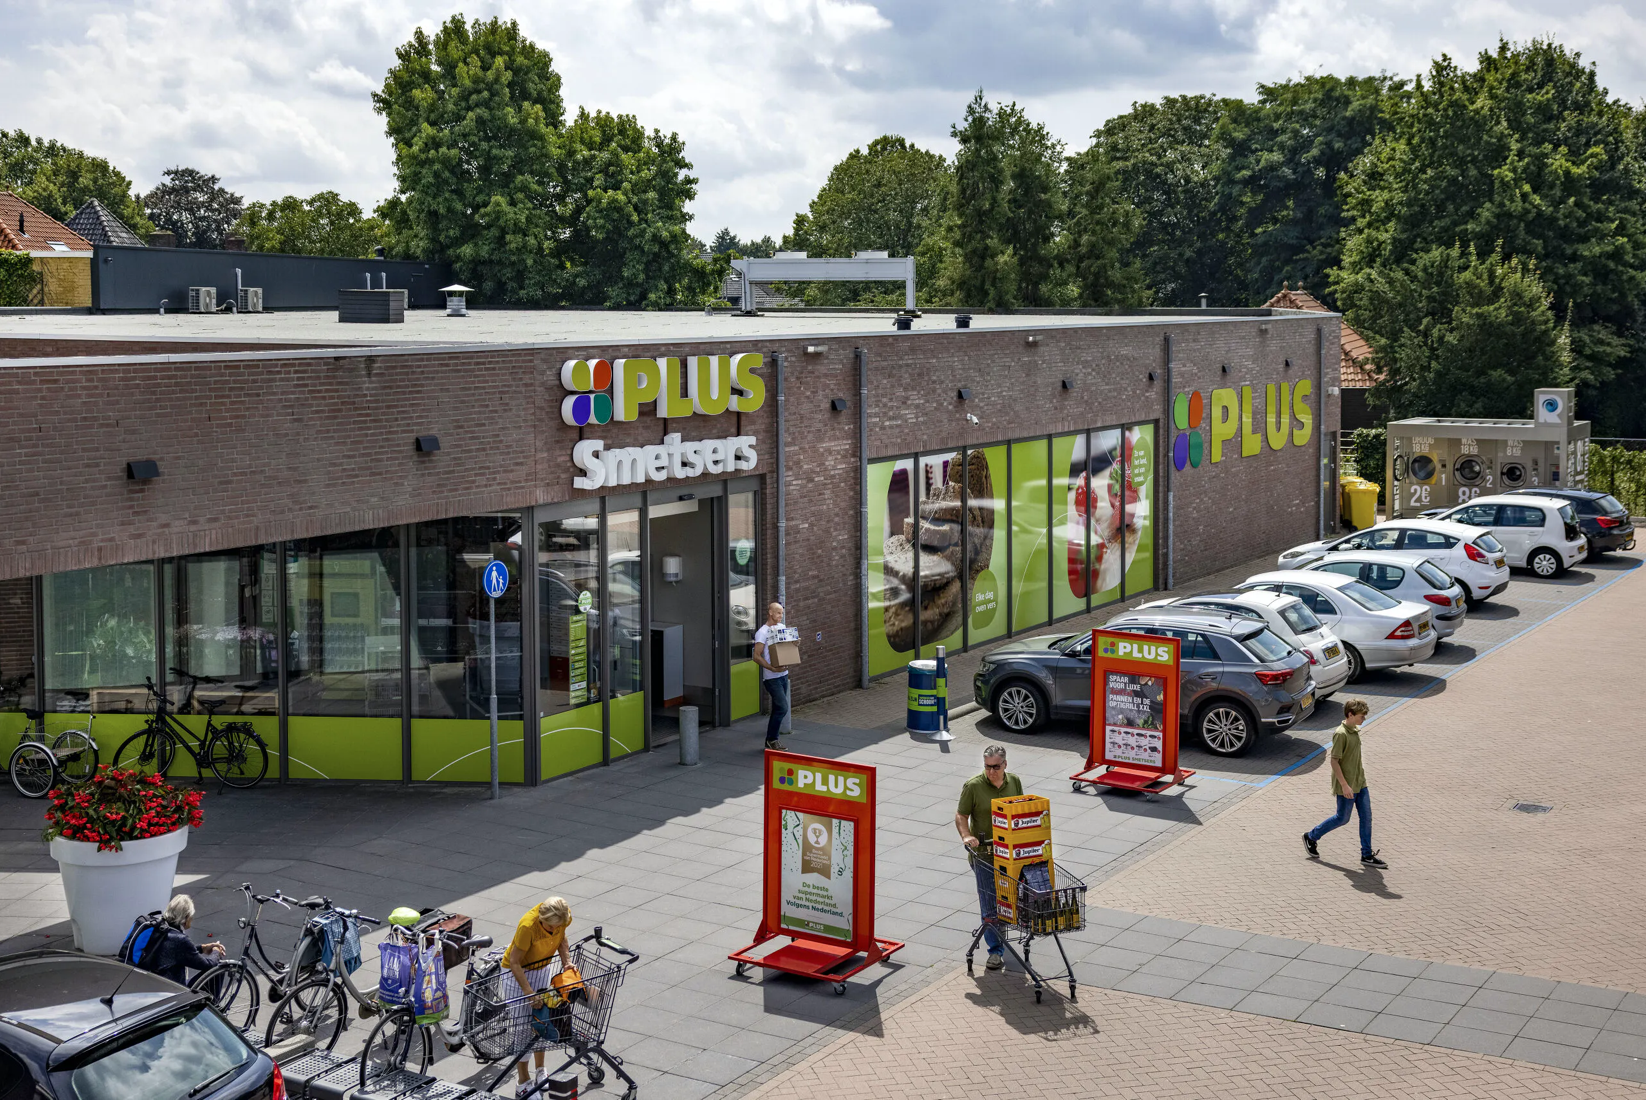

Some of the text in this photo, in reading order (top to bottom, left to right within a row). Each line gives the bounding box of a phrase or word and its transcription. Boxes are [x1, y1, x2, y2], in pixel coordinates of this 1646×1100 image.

[613, 353, 765, 422] PLUS
[1211, 379, 1312, 464] PLUS
[1412, 444, 1420, 452] 18
[1461, 445, 1469, 454] 18
[1506, 447, 1512, 455] 8
[572, 432, 758, 490] Smetsers
[1441, 474, 1446, 485] 1
[1486, 475, 1493, 487] 2
[1410, 485, 1430, 506] 2€
[1118, 642, 1169, 661] PLUS
[1109, 675, 1129, 683] SPAAR
[1109, 695, 1132, 703] PANNEN
[1109, 701, 1138, 710] OPTIGRILL
[798, 770, 861, 796] PLUS
[812, 884, 829, 892] beste
[798, 889, 833, 900] supermarkt
[786, 900, 810, 910] Volgens
[812, 906, 845, 917] Nederland.
[805, 897, 838, 909] Nederland.
